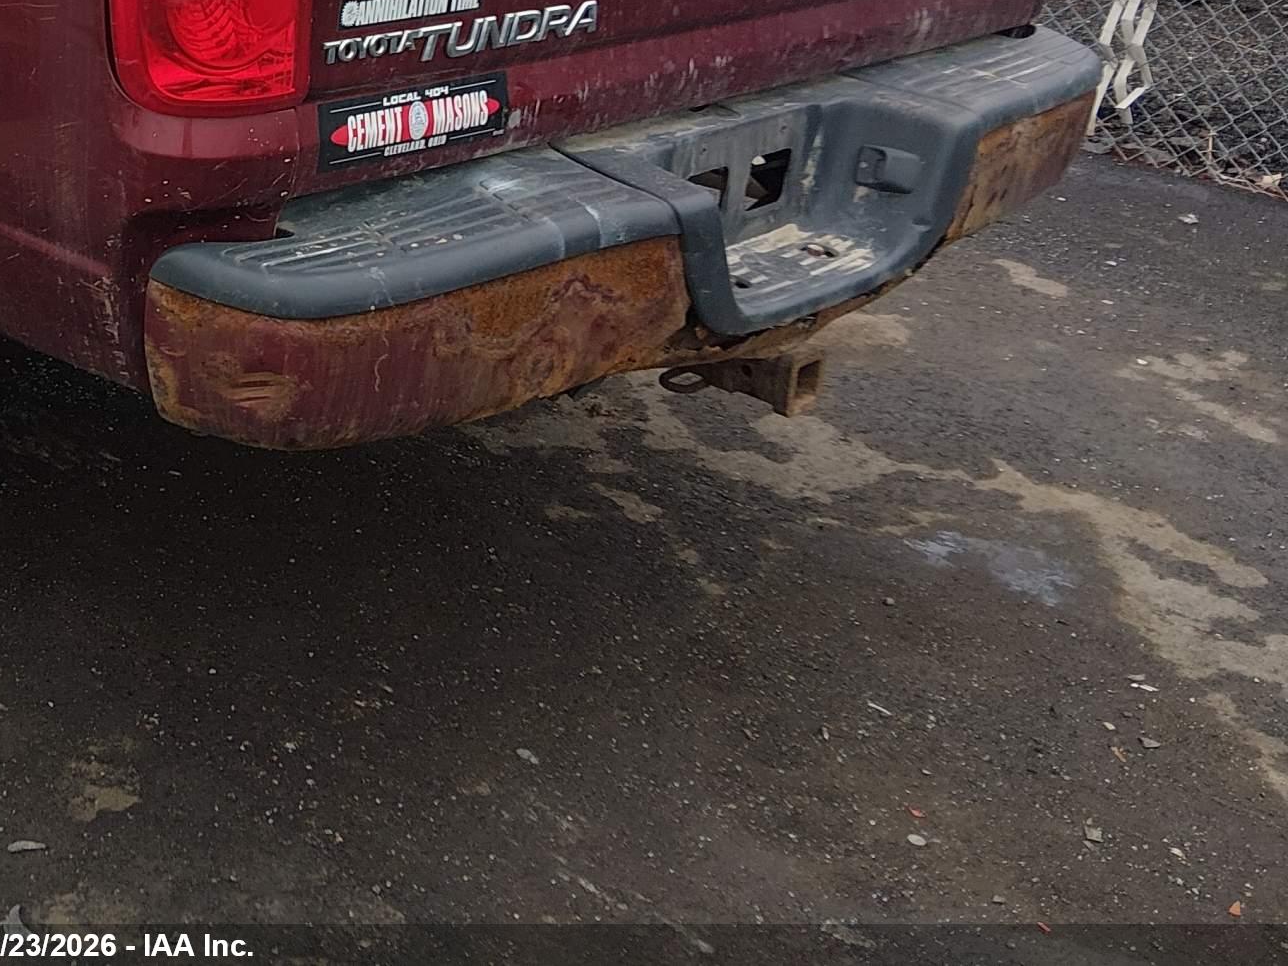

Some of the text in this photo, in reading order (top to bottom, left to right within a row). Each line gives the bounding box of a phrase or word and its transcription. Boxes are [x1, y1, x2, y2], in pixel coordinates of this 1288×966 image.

[323, 0, 598, 65] TOYOTA TUNDRA
[347, 89, 489, 153] CEMENT MASONS
[383, 85, 450, 107] LOCAL 404
